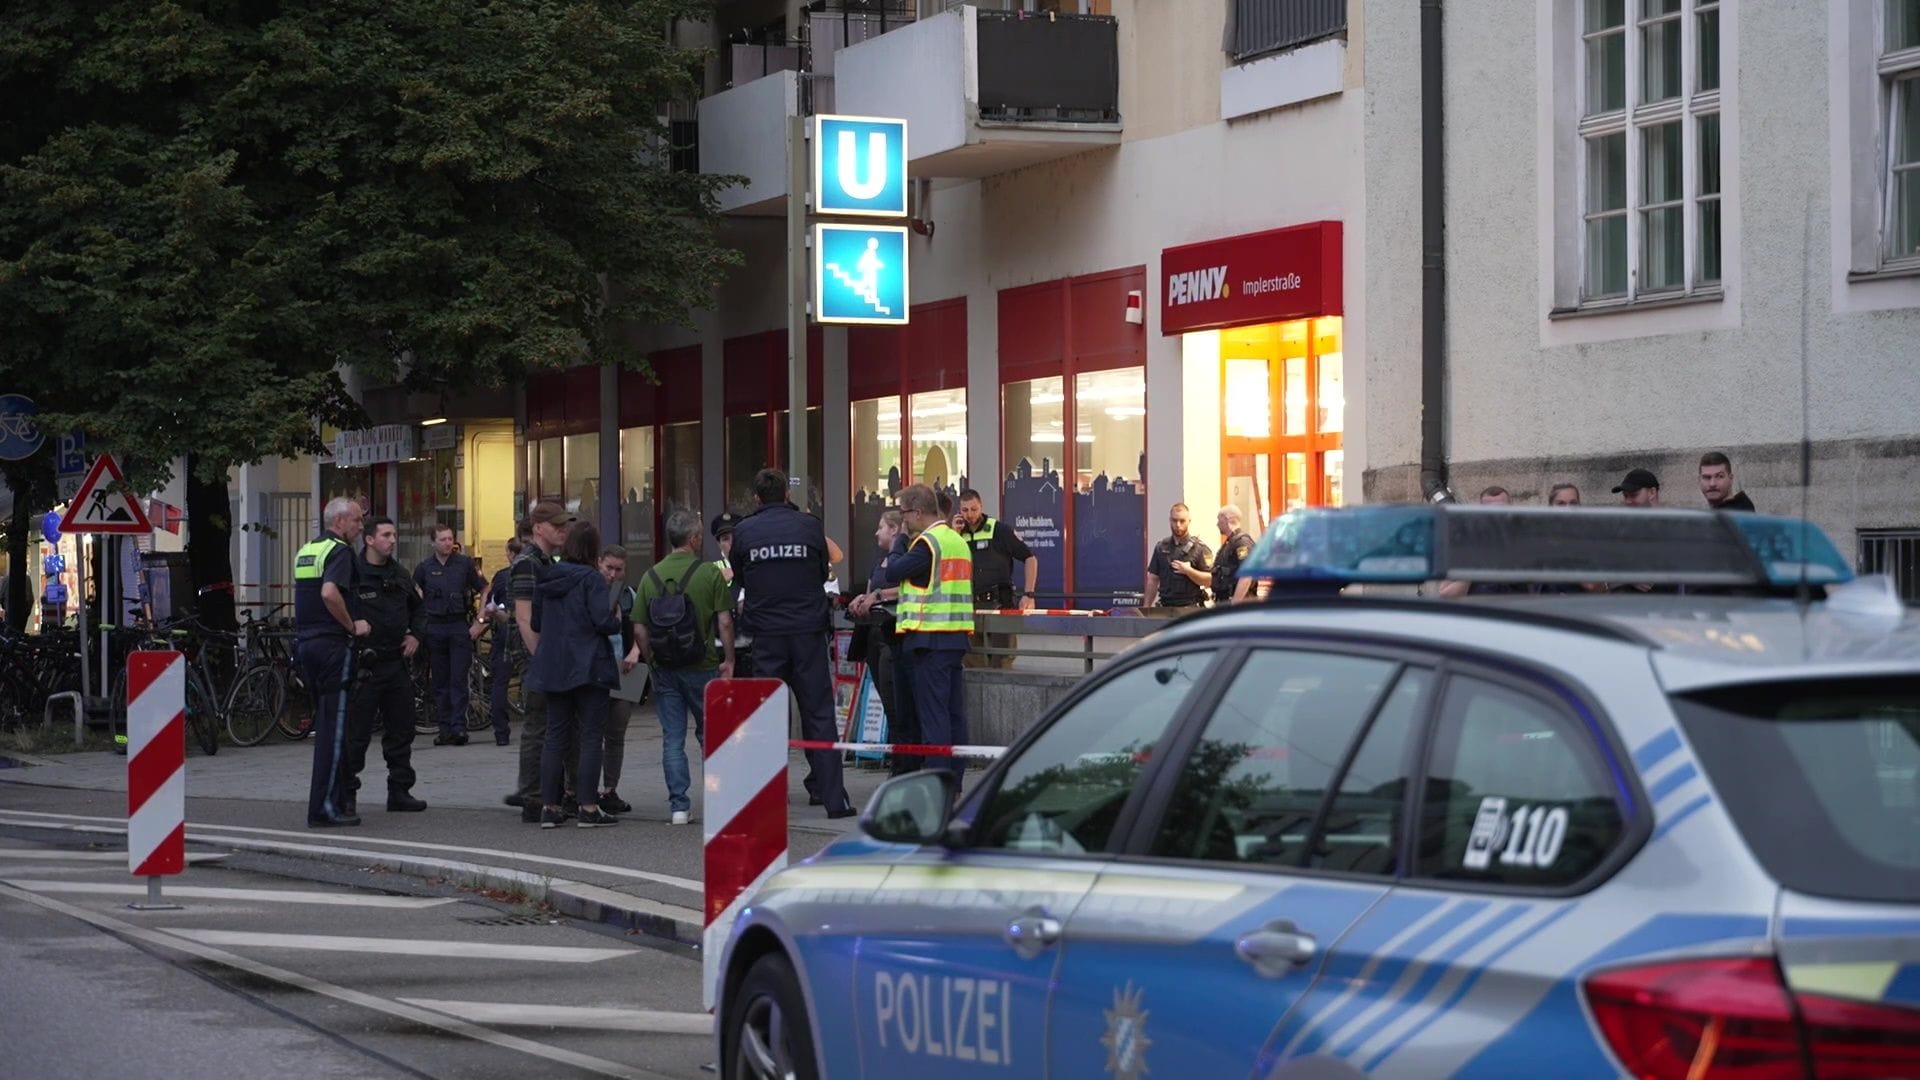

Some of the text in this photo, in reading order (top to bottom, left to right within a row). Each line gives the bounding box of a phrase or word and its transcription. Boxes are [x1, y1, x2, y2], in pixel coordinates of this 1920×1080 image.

[838, 131, 887, 200] U
[1243, 273, 1301, 297] Implerstraße
[61, 435, 76, 469] P
[749, 545, 808, 561] POLIZEI
[1499, 804, 1569, 868] 110
[875, 970, 1011, 1066] POLIZEI
